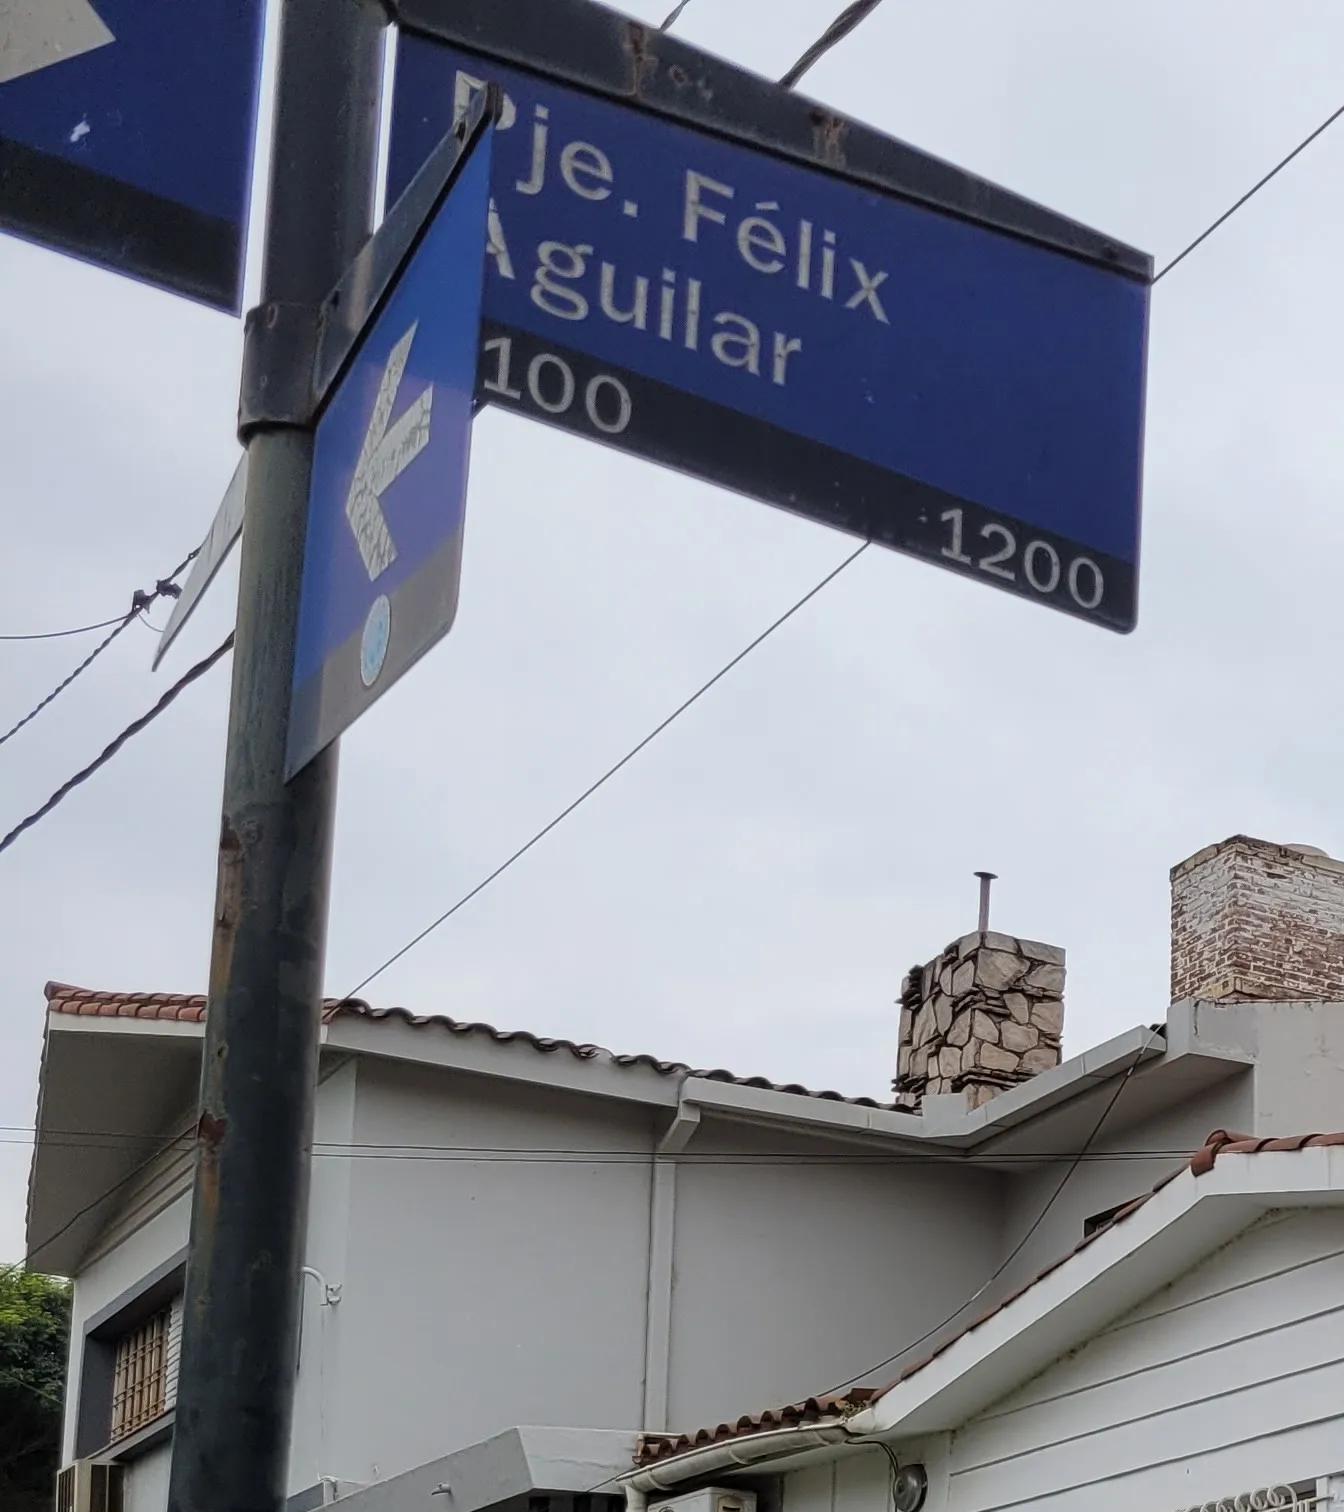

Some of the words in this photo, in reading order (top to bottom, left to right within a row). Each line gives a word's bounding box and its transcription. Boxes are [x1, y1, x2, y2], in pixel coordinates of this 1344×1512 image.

[453, 69, 639, 219] Pje.
[681, 168, 891, 325] Félix
[940, 507, 1104, 609] 1200
